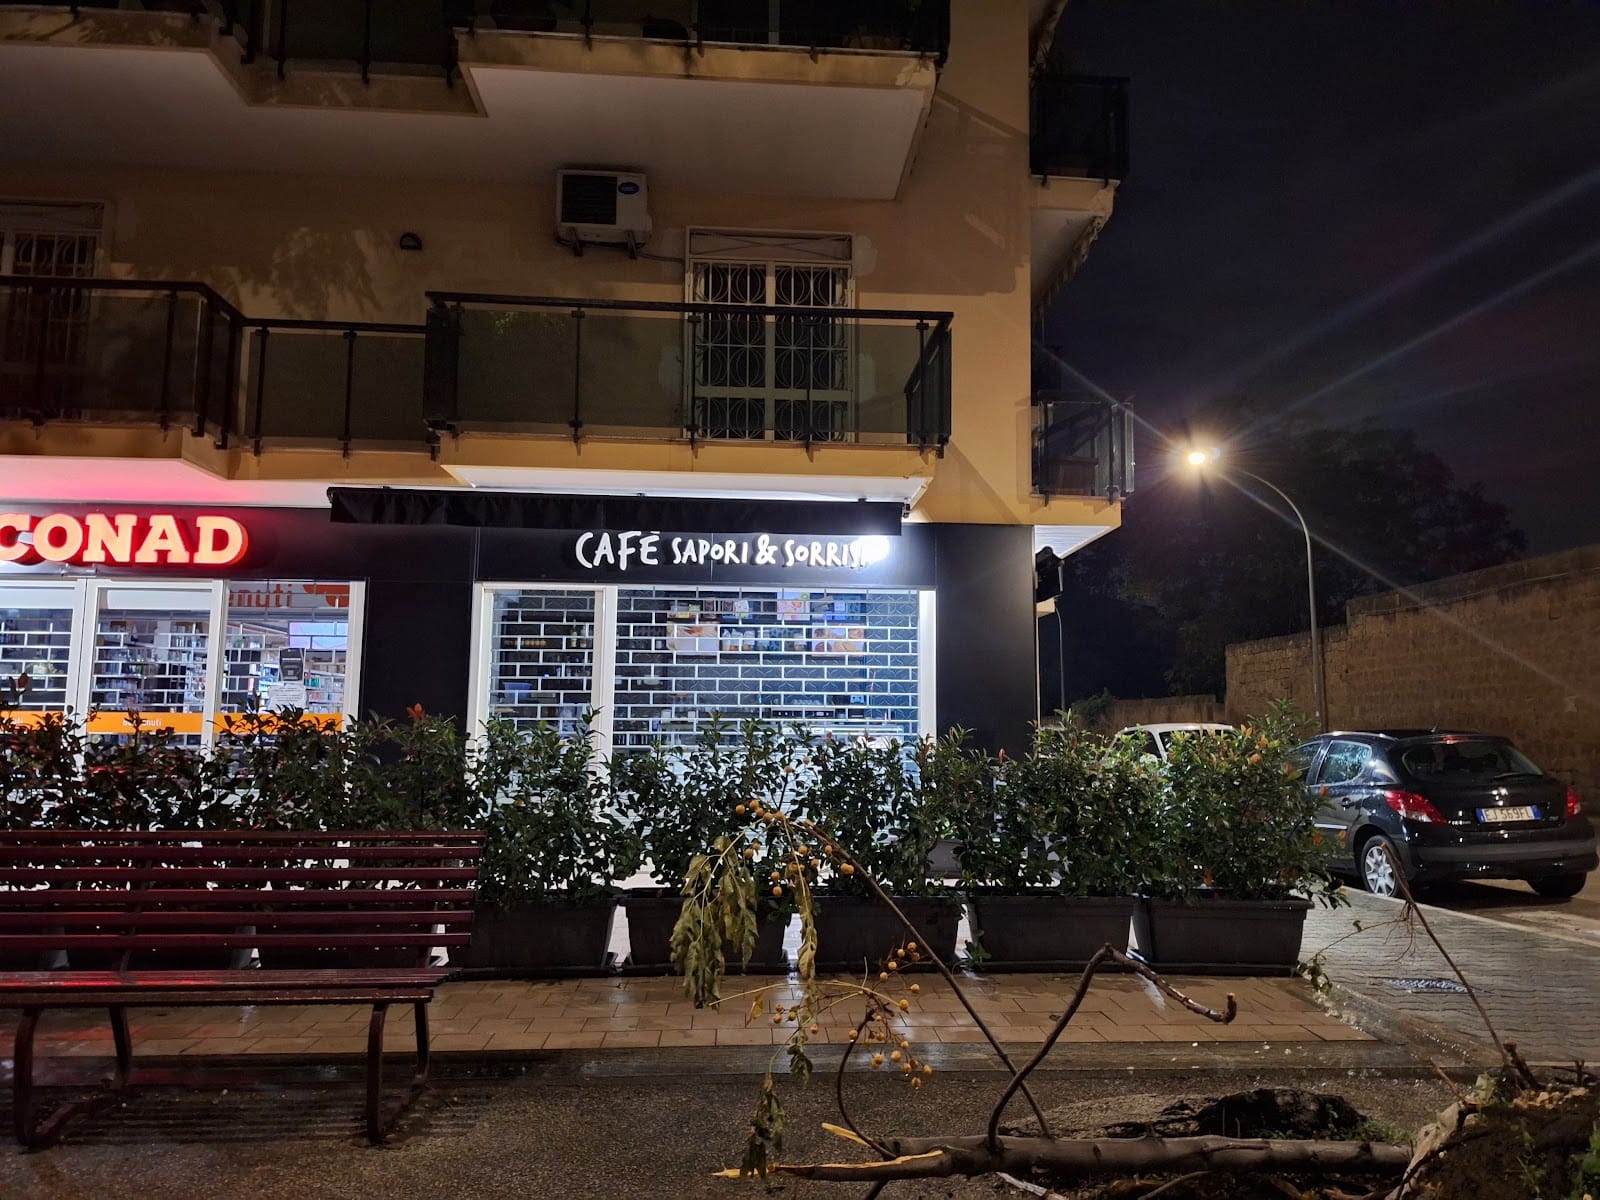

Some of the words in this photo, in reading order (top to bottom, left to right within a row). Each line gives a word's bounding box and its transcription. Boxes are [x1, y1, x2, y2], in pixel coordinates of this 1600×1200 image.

[0, 512, 247, 564] CONAD
[671, 536, 748, 565] SAPORI
[755, 533, 778, 565] &
